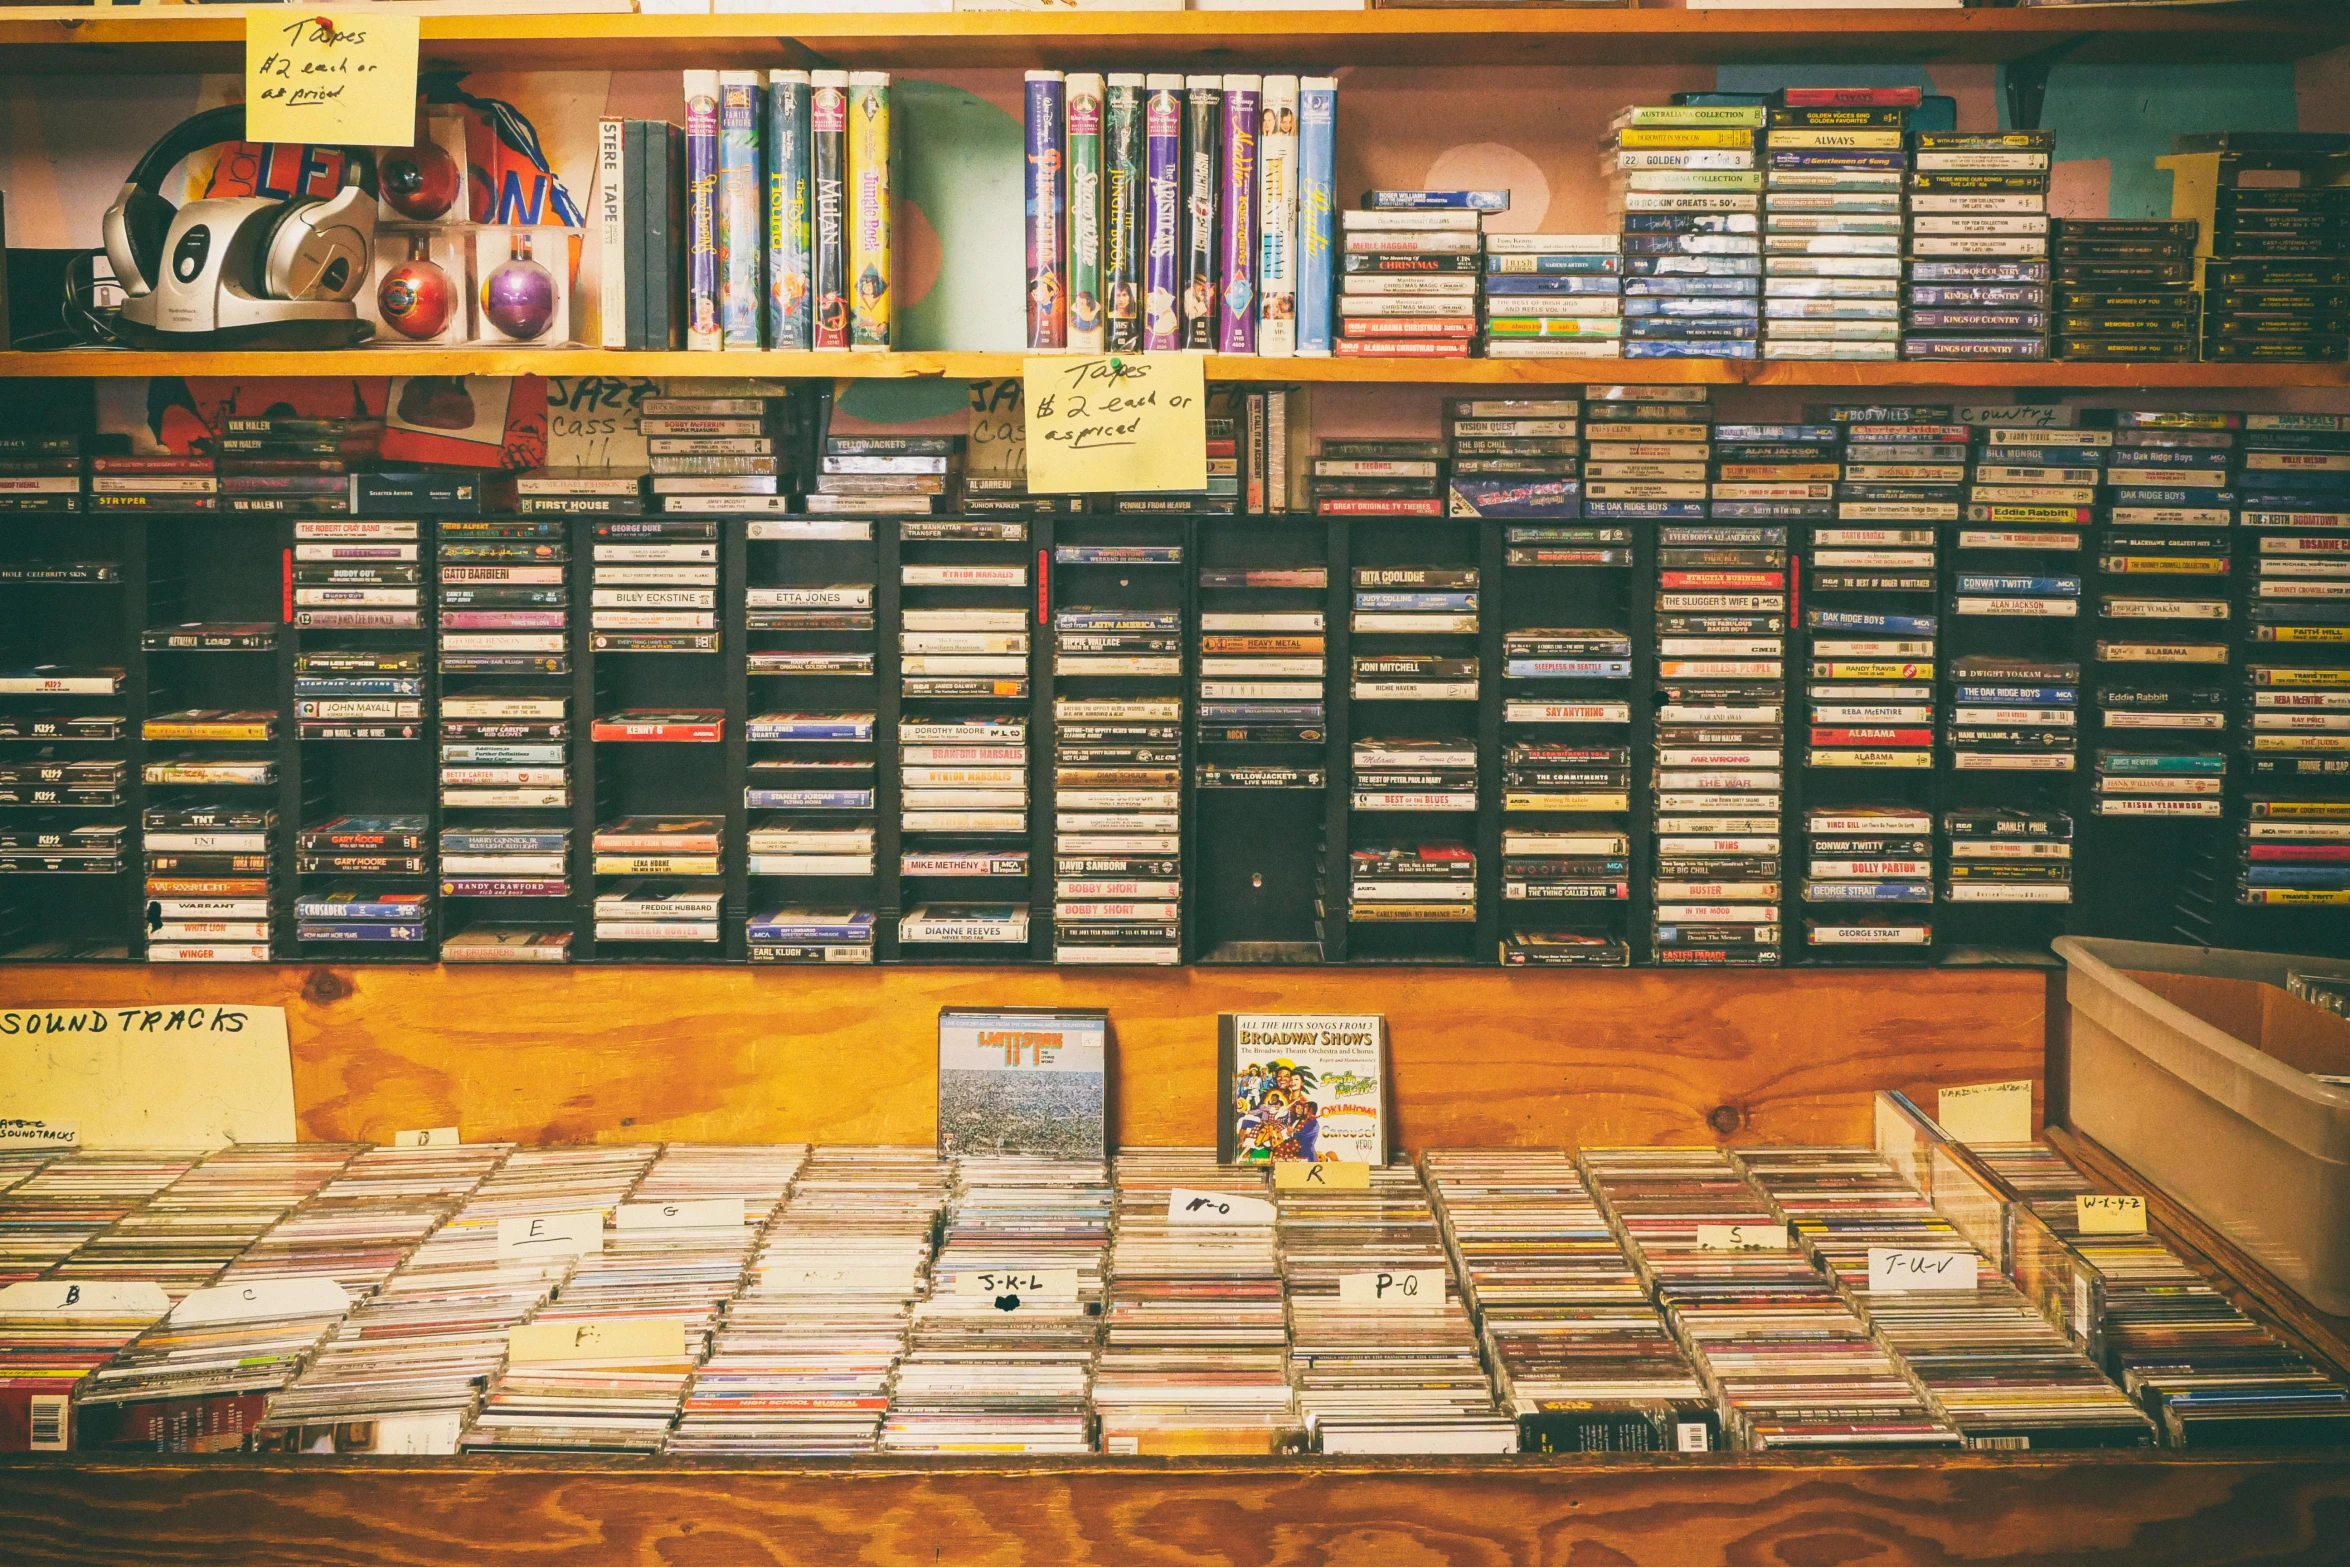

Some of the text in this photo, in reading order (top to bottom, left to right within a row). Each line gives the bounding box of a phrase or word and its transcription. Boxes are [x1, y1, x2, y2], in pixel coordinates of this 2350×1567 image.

[283, 18, 367, 47] Tapes
[301, 58, 347, 74] each
[358, 63, 377, 73] or
[605, 184, 617, 222] TAPE
[1380, 261, 1439, 269] CHRISTMAS
[1944, 316, 2020, 324] KINGS OF COUNTRY
[1934, 345, 2013, 354] KINGS OF COUNTRY
[1065, 360, 1151, 389] Tapes
[1068, 396, 1089, 418] 2
[1099, 391, 1155, 411] each
[1170, 396, 1192, 408] or
[229, 421, 270, 430] VAN HALEN
[224, 440, 261, 448] VAN HALEN
[2121, 491, 2137, 499] OAK
[2139, 491, 2162, 500] RIDGE
[2165, 491, 2185, 500] BOYS
[100, 497, 146, 505] STRYPER
[536, 501, 609, 510] FIRST HOUSE
[611, 524, 662, 532] GEORGE DUKE
[334, 569, 376, 578] BUDDY GUY
[443, 569, 509, 580] GATO BARBIERI
[1361, 571, 1424, 582] RITA COOLIDGE
[616, 593, 696, 602] BILLY ECKSTINE
[776, 593, 840, 602] ETTA JONES
[1360, 662, 1420, 672] JONI MITCHELL
[1970, 670, 2041, 678] DWIGHT YOAKAM
[2109, 693, 2168, 703] Eddie Rabbitt
[327, 703, 390, 712] JOHN MAYALL
[34, 724, 55, 733] KISS
[1848, 729, 1895, 738] ALABAMA
[1854, 753, 1894, 761] ALABAMA
[41, 769, 62, 778] KISS
[35, 791, 56, 800] KISS
[1385, 796, 1404, 804] BEST
[1425, 796, 1449, 804] BLUES
[2157, 802, 2203, 810] YEARWOOD
[192, 815, 215, 824] TNT
[39, 835, 60, 845] KISS
[194, 837, 215, 845] TNT
[331, 836, 384, 844] GARY MOORE
[1714, 841, 1738, 850] TWINS
[1815, 841, 1883, 850] CONWAY TWITTY
[1059, 862, 1127, 871] DAVID SANBORN
[1852, 863, 1915, 873] DOLLY PARTON
[1069, 884, 1138, 893] BOBBY SHORT
[1689, 885, 1722, 895] BUSTER
[1065, 905, 1134, 914] BOBBY SHORT
[925, 927, 1001, 935] DIANNE REEVES
[1838, 929, 1871, 937] GEORGE
[179, 950, 214, 958] WINGER
[754, 948, 801, 956] EARL KLUGH
[1339, 1022, 1366, 1030] FROM
[1240, 1030, 1373, 1046] BROADWAY SHOWS
[1320, 1070, 1356, 1087] South
[1335, 1078, 1377, 1099] Pacific
[1320, 1104, 1377, 1119] OKLAHOMA
[1322, 1124, 1375, 1138] Carousel
[1306, 1164, 1326, 1185] R
[662, 1206, 679, 1217] G
[529, 1219, 545, 1237] E
[1729, 1227, 1742, 1243] S
[1376, 1273, 1419, 1299] P-Q
[242, 1288, 257, 1301] C
